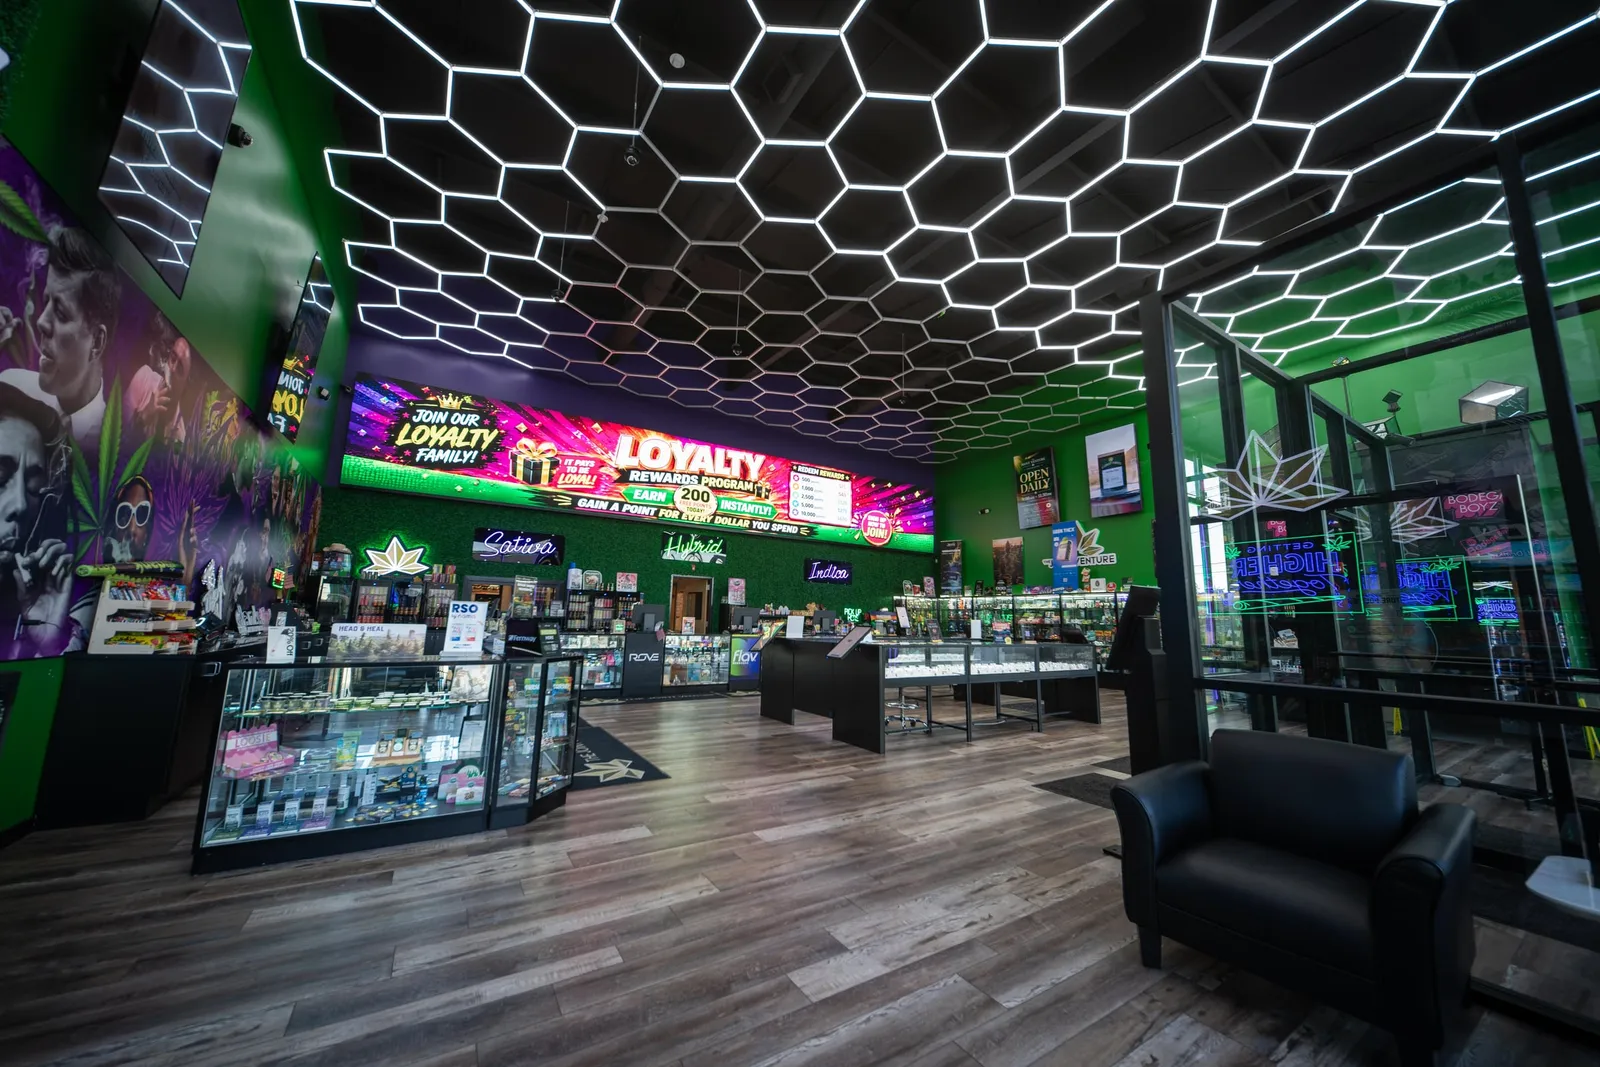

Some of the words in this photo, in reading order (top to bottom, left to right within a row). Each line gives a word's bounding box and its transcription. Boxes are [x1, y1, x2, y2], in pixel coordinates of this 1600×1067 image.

[413, 409, 447, 424] JOIN
[451, 411, 480, 427] OUR
[396, 424, 499, 450] LOYALTY
[415, 447, 478, 464] FAMILY!
[564, 458, 571, 466] IT
[572, 459, 595, 468] PAYS
[614, 434, 765, 481] LOYALTY
[578, 466, 589, 474] BE
[819, 469, 845, 480] REWARDS
[1019, 467, 1049, 484] OPEN
[558, 473, 598, 485] LOYAL!
[629, 469, 699, 486] REWARDS
[701, 476, 754, 492] PROGRAM
[1020, 478, 1051, 494] DAILY
[633, 488, 667, 502] EARN
[681, 488, 710, 503] 200
[720, 499, 772, 516] INSTANTLY!
[1459, 501, 1499, 513] BOYZ
[577, 498, 609, 511] GAIN
[610, 502, 620, 512] A
[622, 504, 657, 516] POINT
[658, 508, 680, 519] FOR
[681, 513, 713, 523] EVERY
[714, 516, 750, 528] DOLLAR
[752, 521, 770, 530] YOU
[771, 523, 798, 534] SPEND
[866, 527, 888, 539] JOIN!
[483, 531, 557, 557] Sativa
[667, 533, 723, 556] Hybrid
[810, 561, 850, 580] Indica
[452, 604, 479, 614] RSO
[844, 607, 855, 615] PICK
[287, 628, 295, 643] 20%
[286, 644, 294, 656] Off
[628, 653, 660, 662] ROVE
[732, 649, 758, 662] flav
[235, 733, 272, 748] LOOSIE
